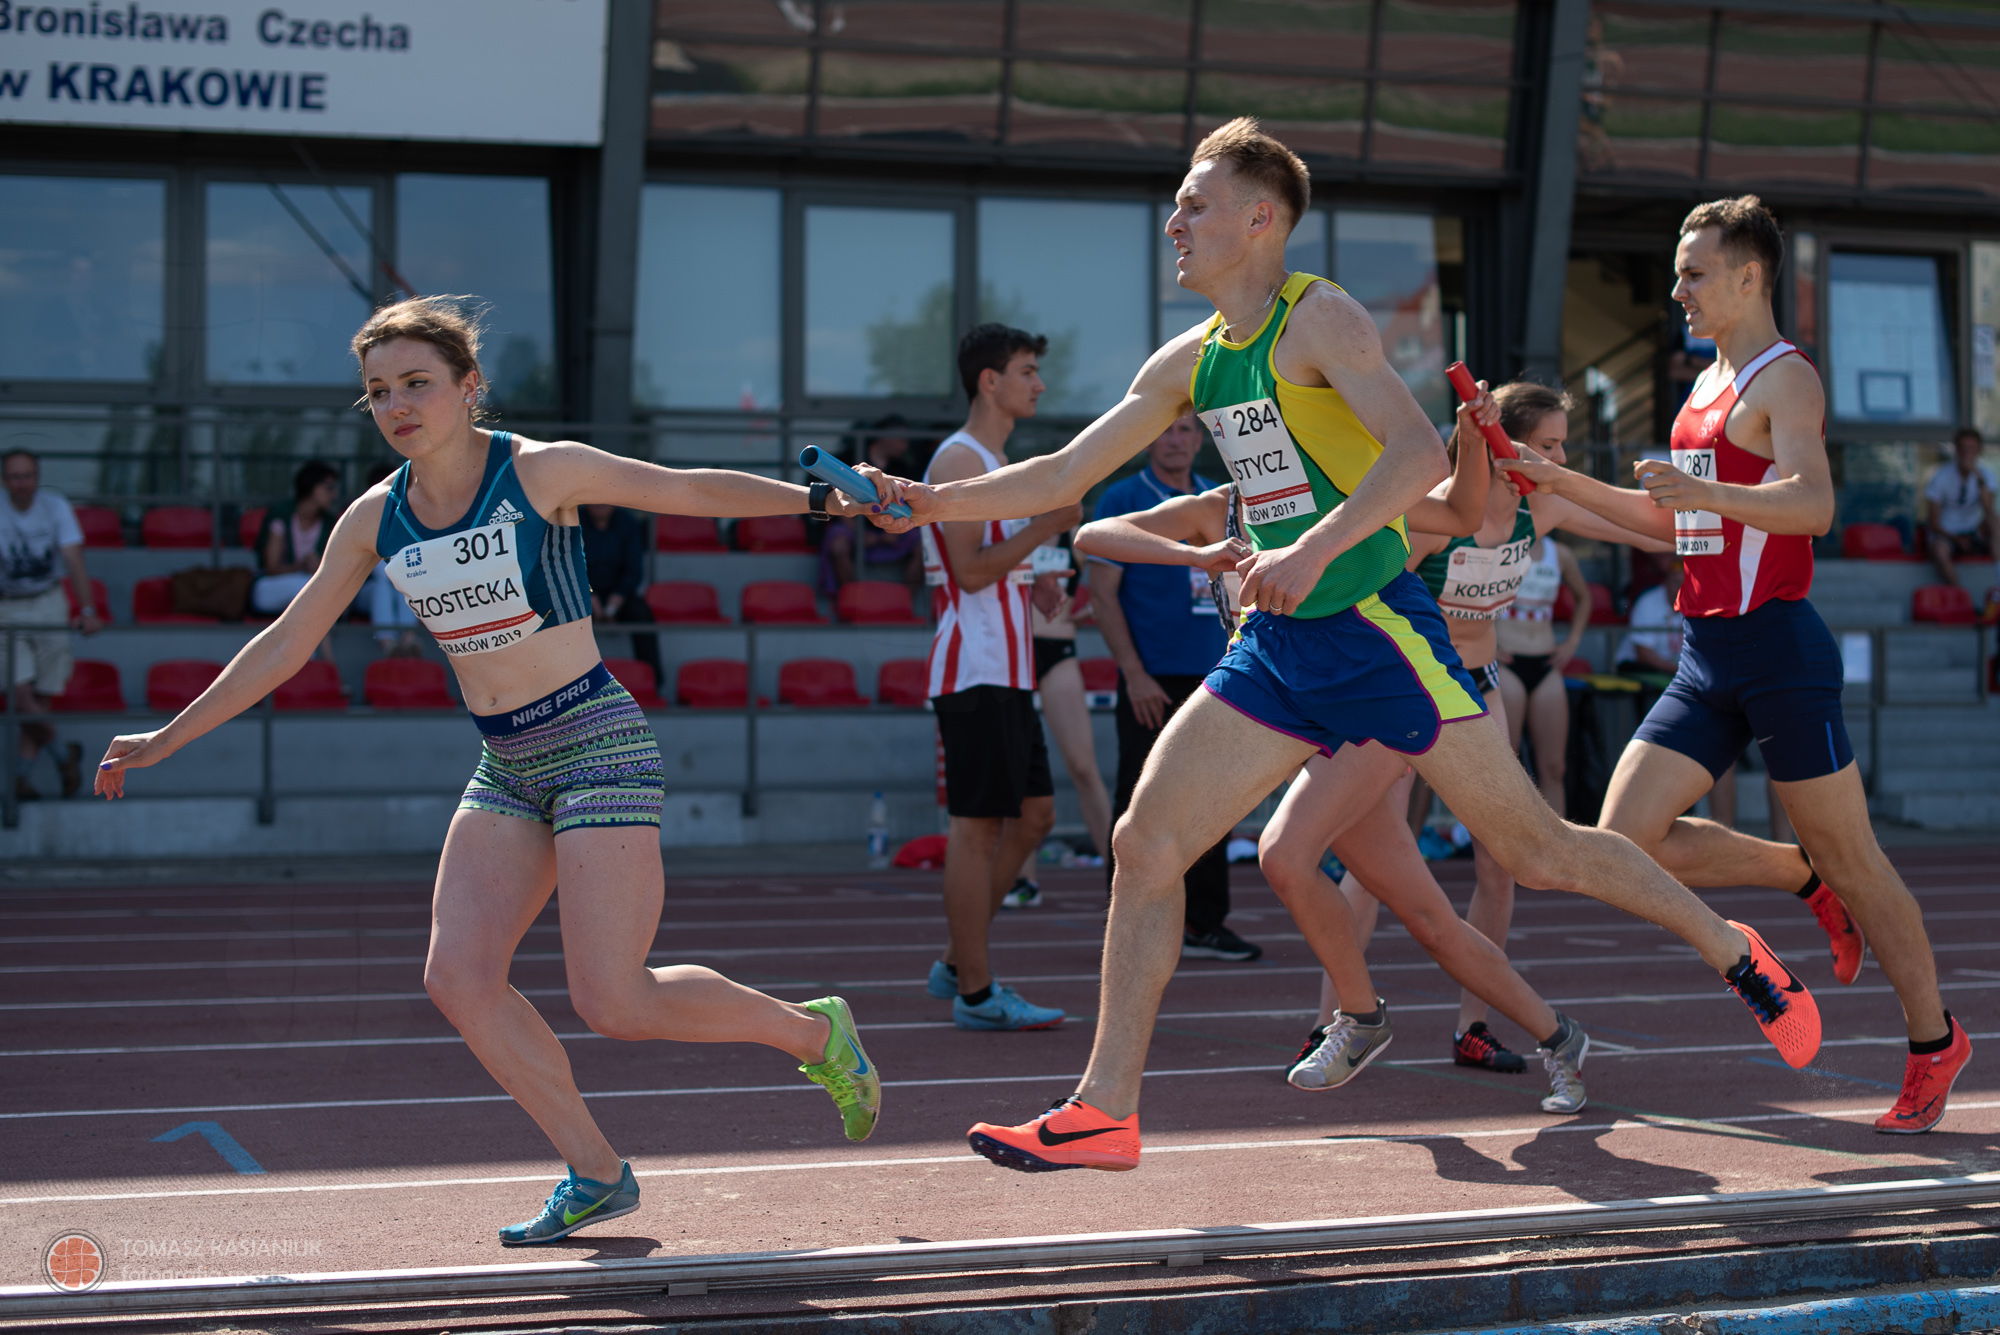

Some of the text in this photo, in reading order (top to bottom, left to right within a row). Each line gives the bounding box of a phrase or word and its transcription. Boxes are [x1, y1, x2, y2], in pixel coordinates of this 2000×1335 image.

[257, 9, 410, 51] Czecha
[48, 61, 328, 111] KRAKOWIE
[1233, 404, 1277, 437] 284
[1230, 450, 1290, 481] STYCZ
[1686, 453, 1712, 477] 287
[488, 511, 524, 526] adidas
[1271, 501, 1296, 518] 2019
[453, 528, 509, 566] 301
[1500, 541, 1530, 566] 218
[1690, 540, 1709, 552] 2019
[406, 569, 428, 579] Kraków
[1454, 575, 1523, 598] KOŁECKA
[408, 577, 520, 618] SZOSTECKA
[443, 629, 522, 655] KRAKÓW 2019
[512, 678, 590, 728] NIKE PRO
